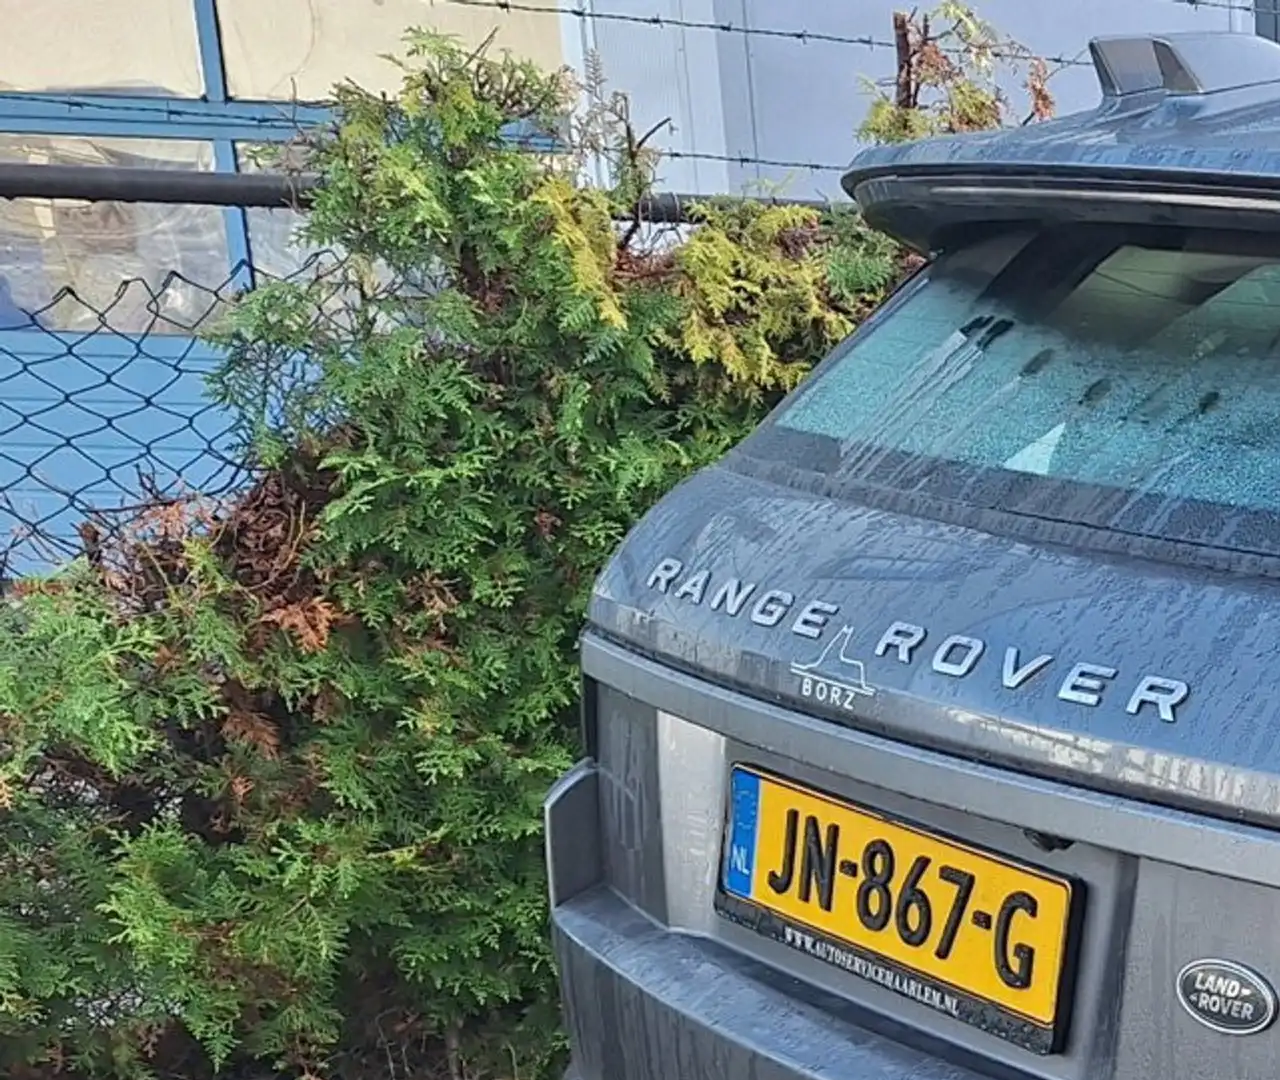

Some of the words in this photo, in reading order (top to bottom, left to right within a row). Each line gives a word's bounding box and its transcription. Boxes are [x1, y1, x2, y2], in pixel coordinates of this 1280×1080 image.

[647, 558, 839, 639] RANGE
[875, 621, 1188, 722] ROVER
[802, 678, 855, 710] BORZ
[732, 845, 750, 875] NL
[768, 808, 1038, 990] JN-867-G
[1198, 992, 1254, 1020] ROVER
